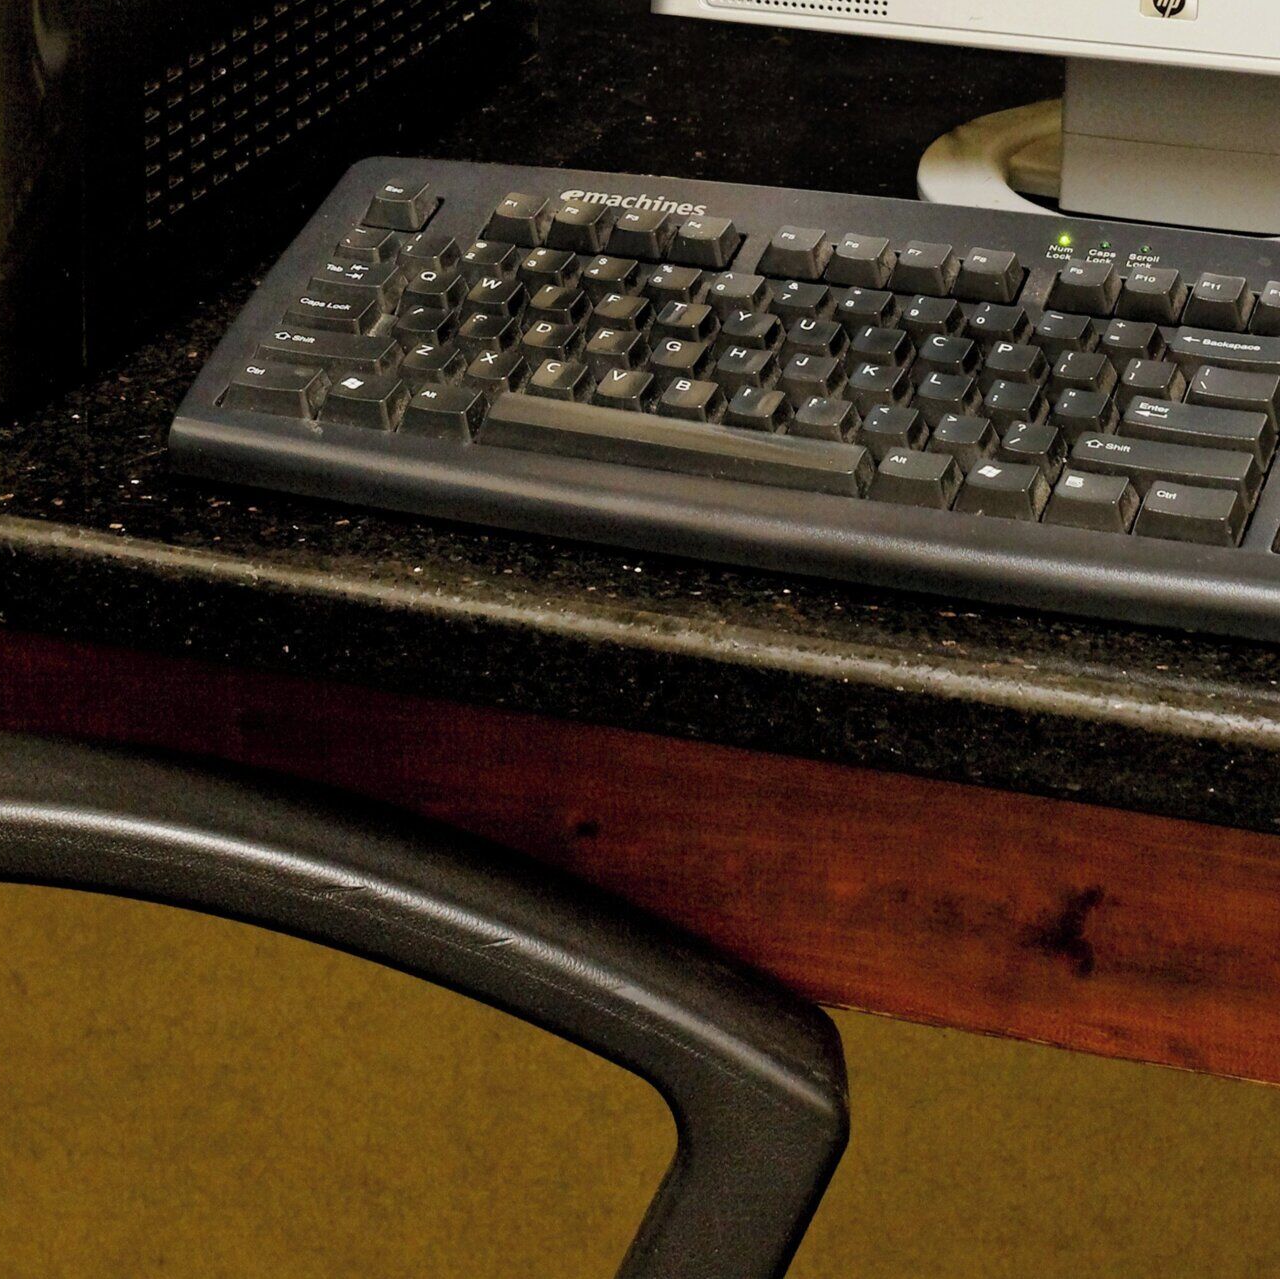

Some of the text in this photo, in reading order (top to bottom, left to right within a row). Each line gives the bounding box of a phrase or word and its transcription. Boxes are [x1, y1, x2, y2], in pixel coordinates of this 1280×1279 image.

[385, 185, 404, 194] Esc
[560, 189, 708, 217] emachines
[565, 207, 579, 215] F2
[688, 221, 702, 229] F4
[908, 248, 922, 256] F7
[1049, 245, 1074, 253] Num
[1089, 249, 1116, 258] Caps
[1046, 252, 1071, 261] Lock
[1128, 253, 1160, 263] Scroll
[327, 263, 344, 273] Tab
[1126, 260, 1152, 269] Lock
[420, 271, 436, 282] Q
[1135, 274, 1156, 283] F10
[482, 278, 503, 289] W
[1202, 281, 1221, 290] F11
[300, 297, 351, 311] Caps Lock
[738, 311, 752, 322] Y
[910, 308, 919, 316] 9
[536, 323, 552, 333] D
[800, 319, 816, 331] U
[292, 334, 316, 344] Shift
[598, 330, 614, 339] F
[416, 345, 433, 356] Z
[666, 341, 682, 352] G
[997, 344, 1013, 354] P
[1202, 339, 1261, 352] Backspace
[730, 348, 747, 358] H
[480, 352, 498, 365] X
[796, 357, 809, 366] J
[246, 366, 265, 376] Ctrl
[546, 362, 561, 373] C
[862, 365, 879, 377] K
[613, 370, 627, 381] V
[930, 374, 941, 385] L
[675, 380, 692, 391] B
[421, 390, 437, 399] Alt
[1139, 402, 1169, 413] Enter
[1105, 442, 1131, 453] Shift
[890, 455, 907, 464] Alt
[1156, 490, 1177, 500] Ctrl
